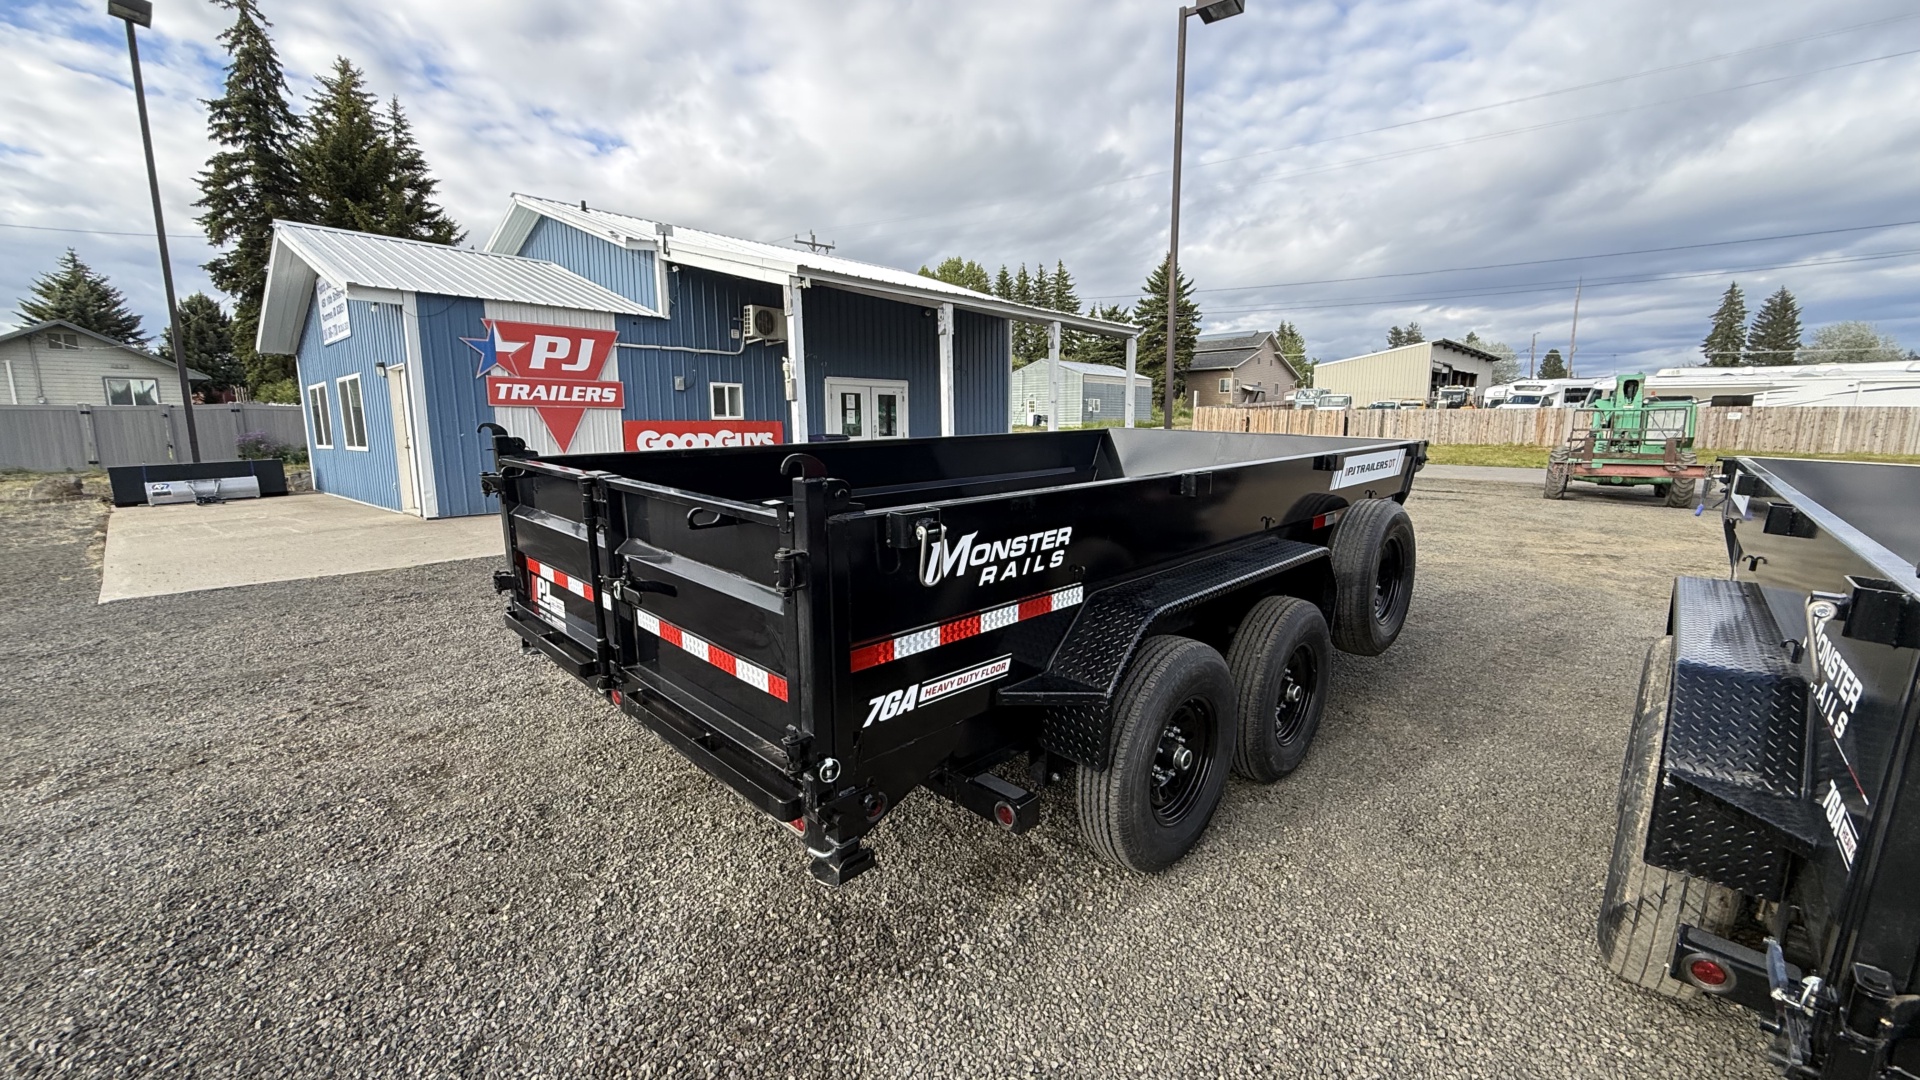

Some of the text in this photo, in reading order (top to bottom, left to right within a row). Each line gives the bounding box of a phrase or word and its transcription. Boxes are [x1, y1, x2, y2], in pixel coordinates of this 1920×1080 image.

[528, 334, 595, 372] PJ
[495, 383, 617, 403] TRAILERS
[1356, 460, 1389, 474] TRAILERS
[924, 526, 1073, 584] MONSTER
[978, 549, 1065, 587] RAILS
[537, 576, 551, 605] PJ
[862, 661, 1007, 729] 7GA HEAVY DUTY FLOOR
[1822, 778, 1847, 838] 7GA
